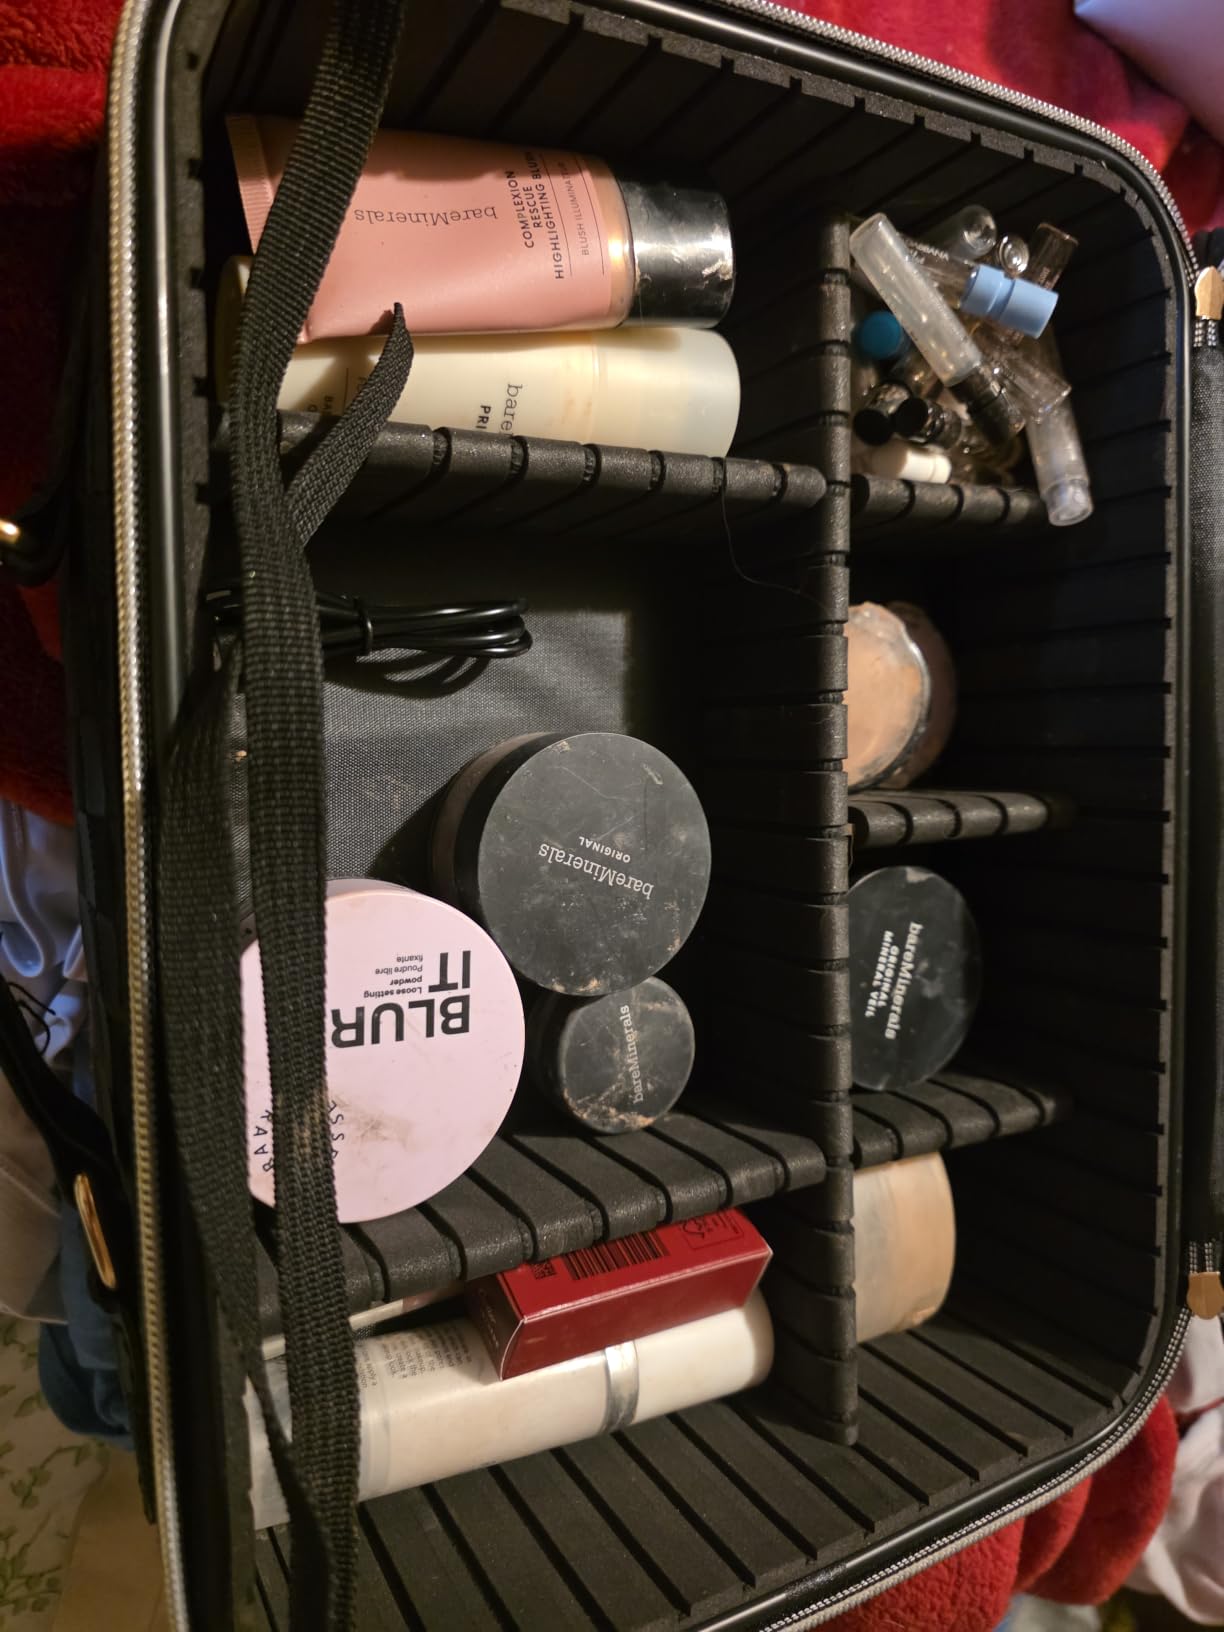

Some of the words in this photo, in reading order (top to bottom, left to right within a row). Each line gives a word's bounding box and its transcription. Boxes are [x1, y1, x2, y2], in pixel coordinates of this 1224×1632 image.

[354, 206, 499, 227] bareMinerals
[504, 170, 534, 248] COMPLEXION
[522, 186, 543, 228] RESCUE
[535, 183, 564, 280] HIGHLIGHTING
[576, 223, 590, 256] BLUSH
[475, 404, 492, 430] PRI
[578, 836, 631, 863] ORIGINAL
[538, 843, 655, 900] bareMinerals
[375, 967, 393, 975] libre
[394, 964, 423, 974] Poudre
[396, 954, 424, 963] fixante
[428, 950, 471, 993] IT
[872, 929, 895, 988] MINERAL
[390, 975, 423, 986] powder
[396, 986, 423, 996] Loose
[876, 945, 900, 1008] ORIGINAL
[884, 921, 924, 1040] bareMinerals
[363, 988, 395, 999] setting
[864, 991, 880, 1018] VEIL
[331, 994, 471, 1049] BLUR
[620, 1004, 644, 1105] bareMinerals
